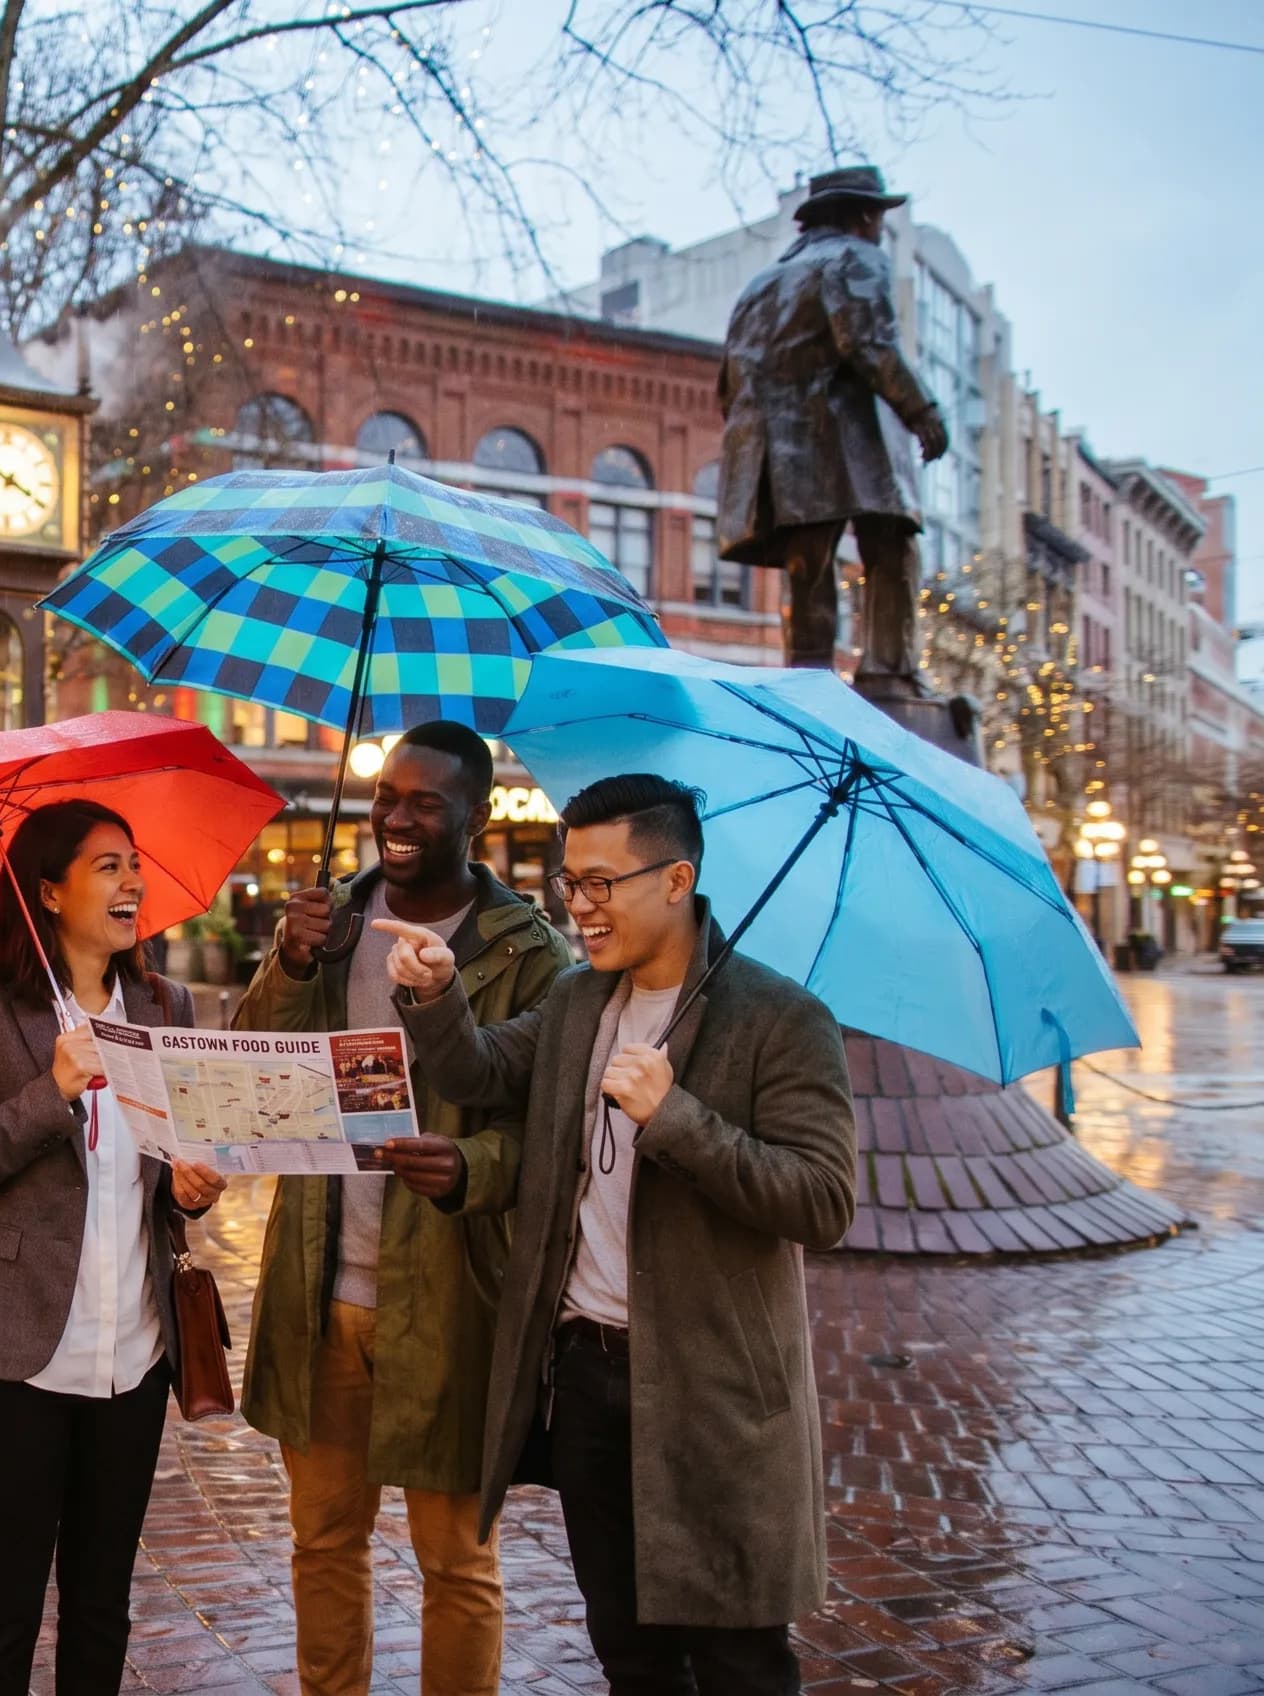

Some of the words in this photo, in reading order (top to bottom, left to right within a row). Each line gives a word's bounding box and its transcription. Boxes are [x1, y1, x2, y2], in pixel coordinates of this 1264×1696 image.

[162, 1035, 229, 1051] GASTOWN
[232, 1039, 270, 1053] FOOD
[275, 1040, 320, 1054] GUIDE
